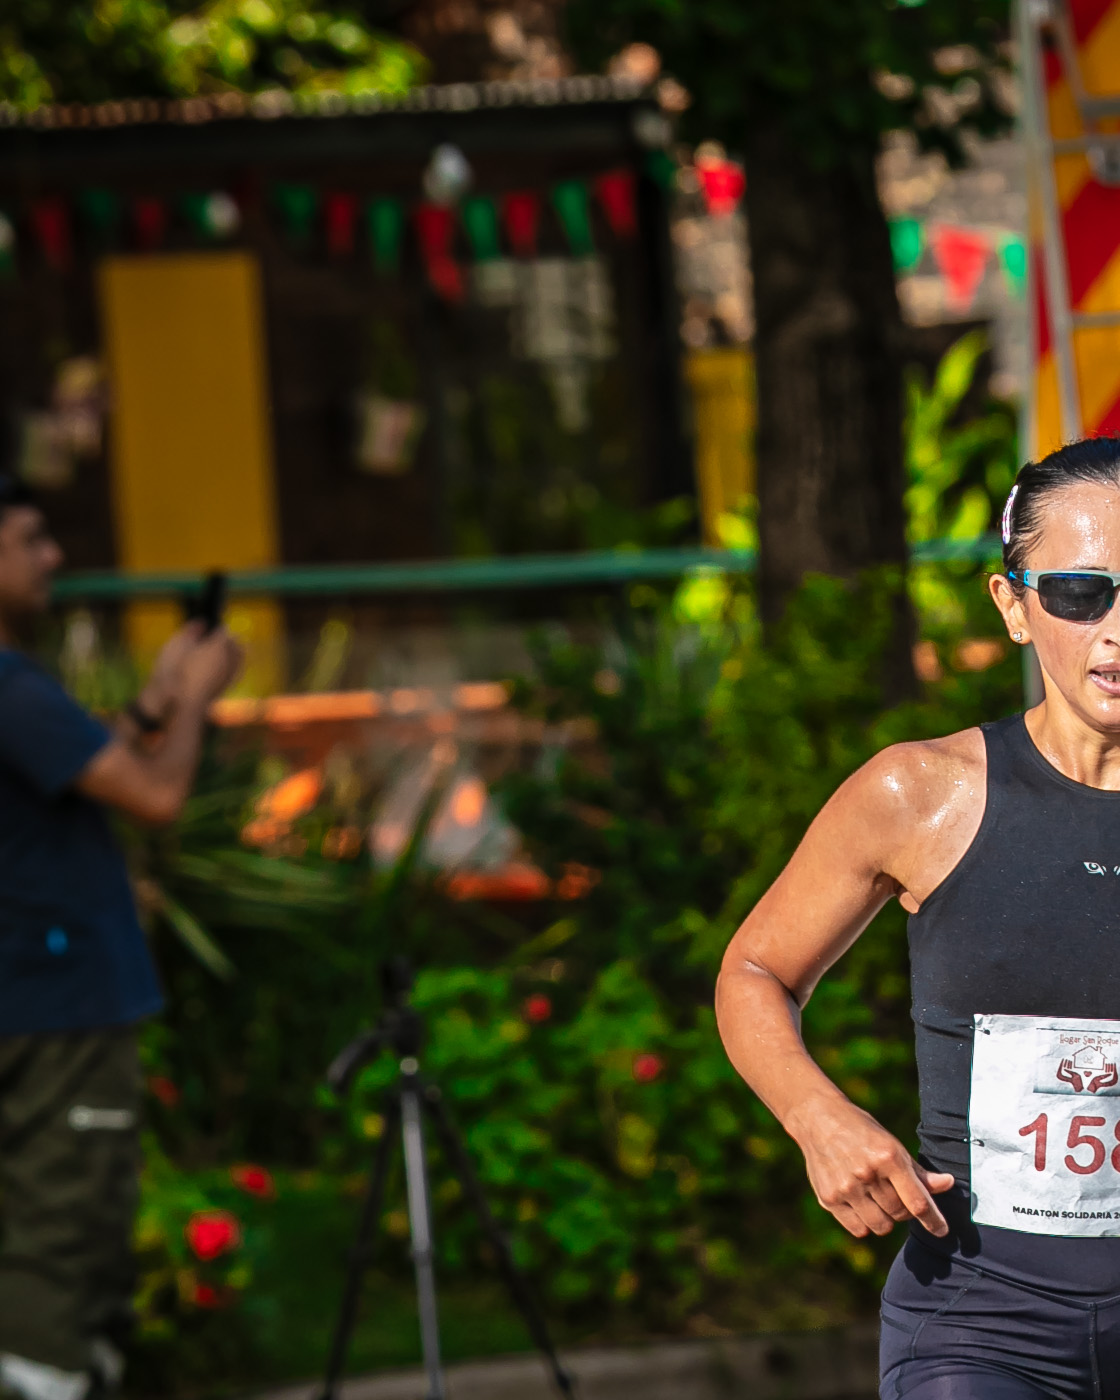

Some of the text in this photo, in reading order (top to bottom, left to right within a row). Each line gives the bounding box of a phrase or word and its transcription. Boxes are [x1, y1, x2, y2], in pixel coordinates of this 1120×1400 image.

[1060, 1034, 1119, 1046] Hogar San Roque
[1012, 1205, 1060, 1218] MARATON
[1061, 1211, 1112, 1219] SOLIDARIA
